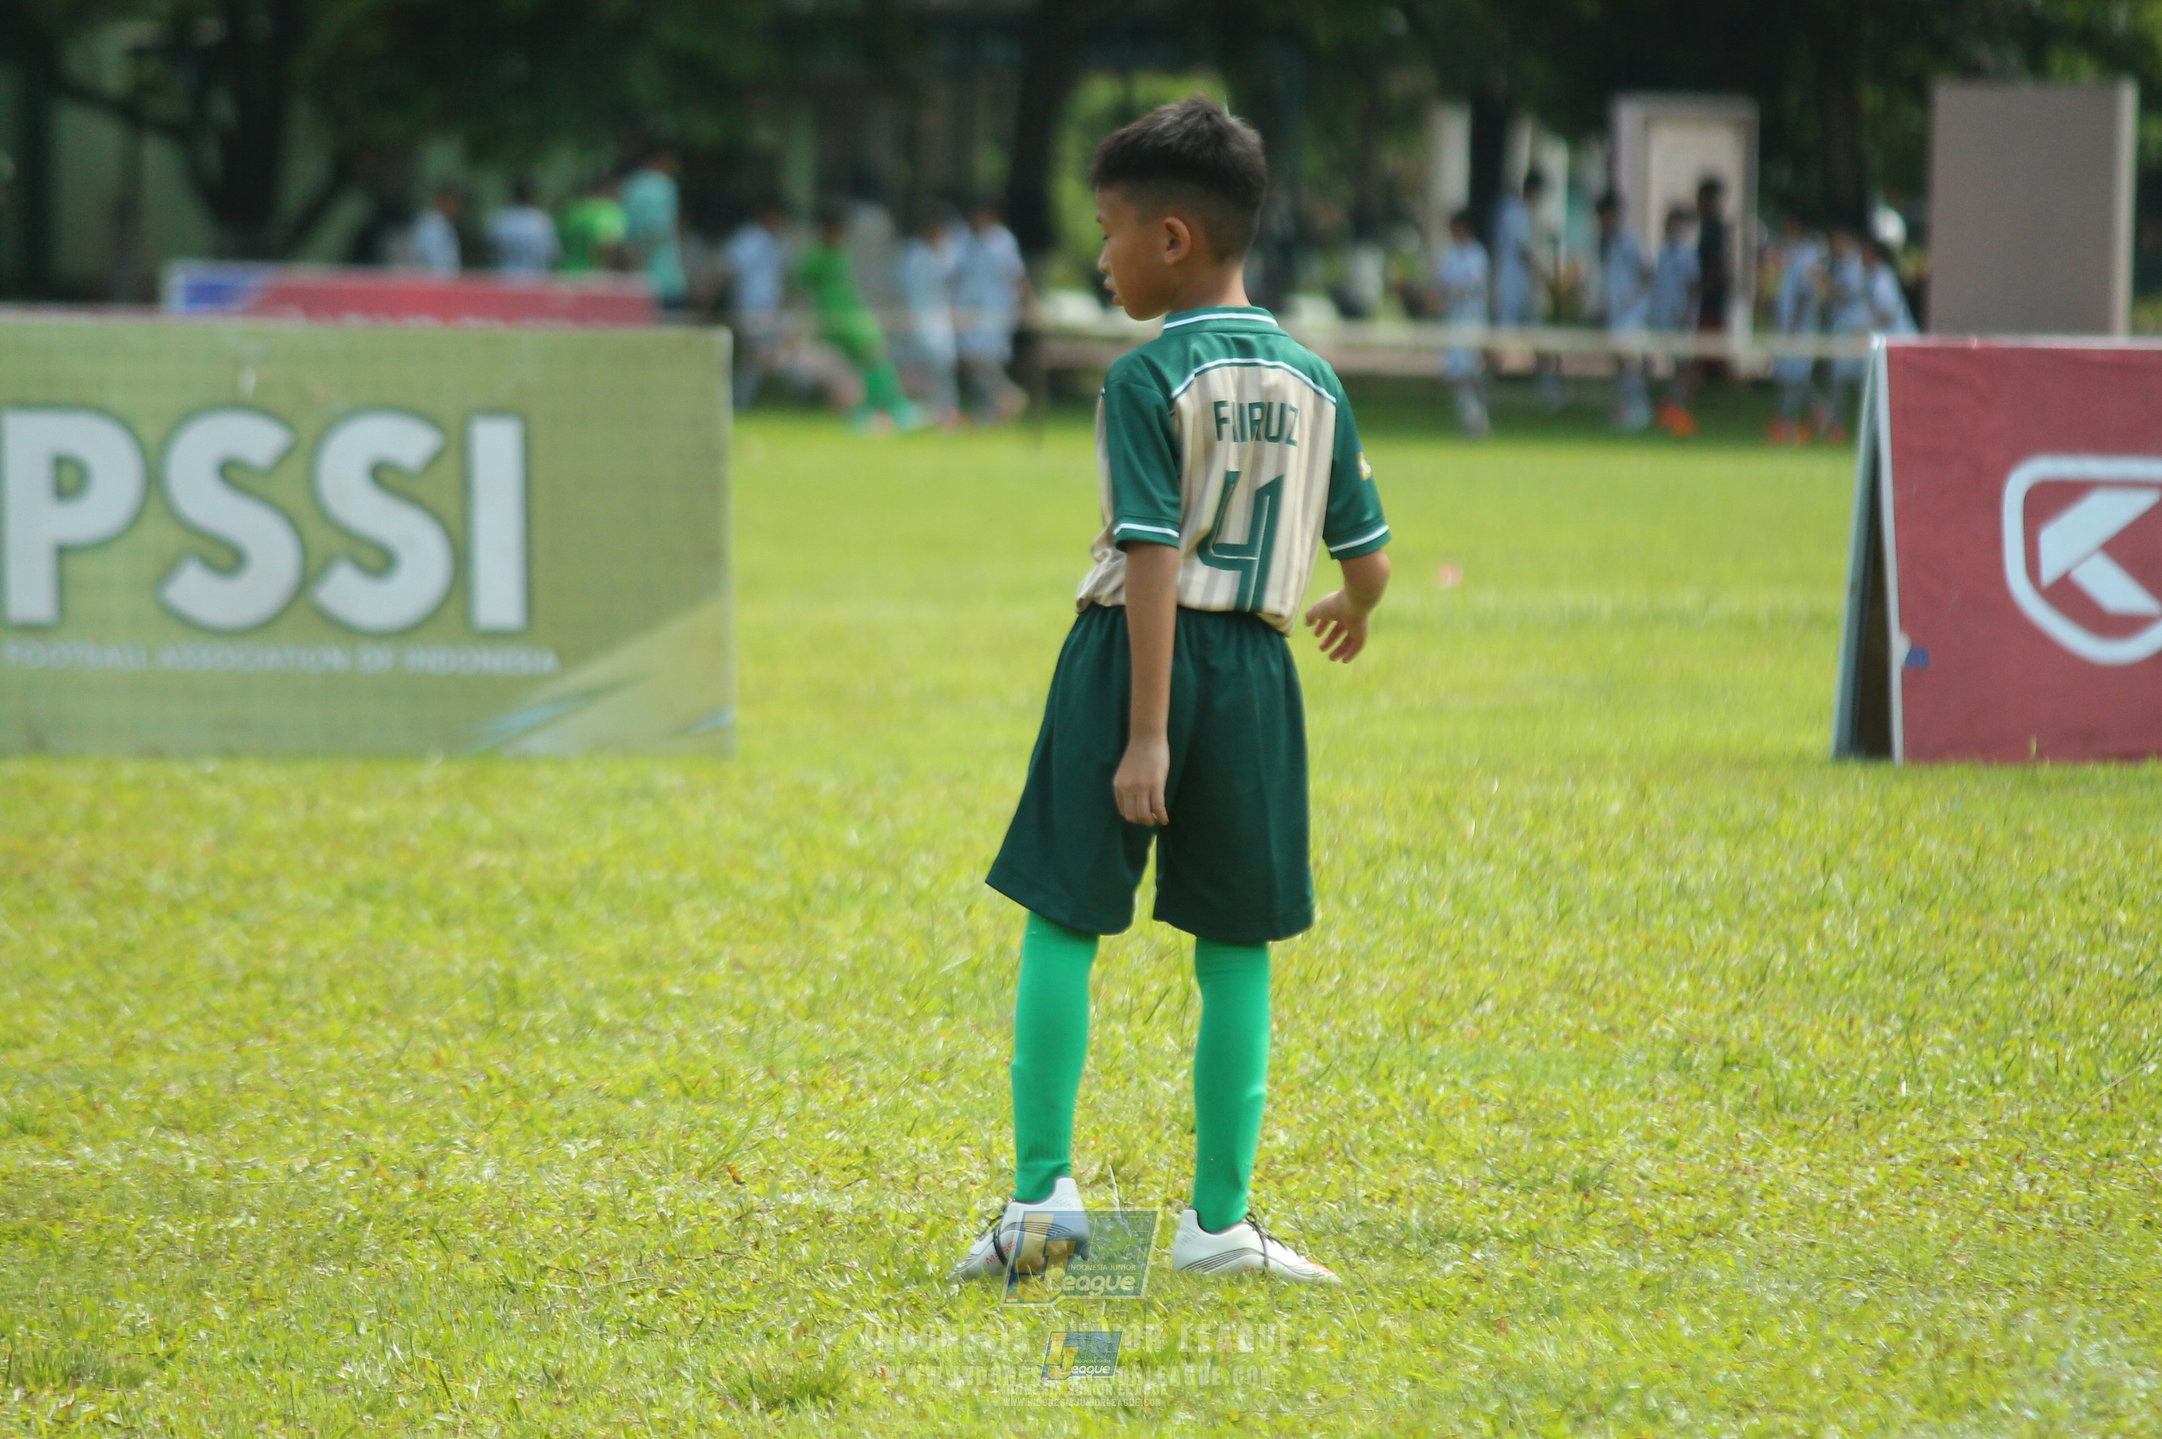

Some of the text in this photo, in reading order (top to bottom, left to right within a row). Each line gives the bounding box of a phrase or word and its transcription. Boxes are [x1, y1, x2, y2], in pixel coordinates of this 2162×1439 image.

[3, 408, 529, 634] PSSI
[1196, 471, 1285, 612] 4
[405, 648, 562, 677] INDONESIA
